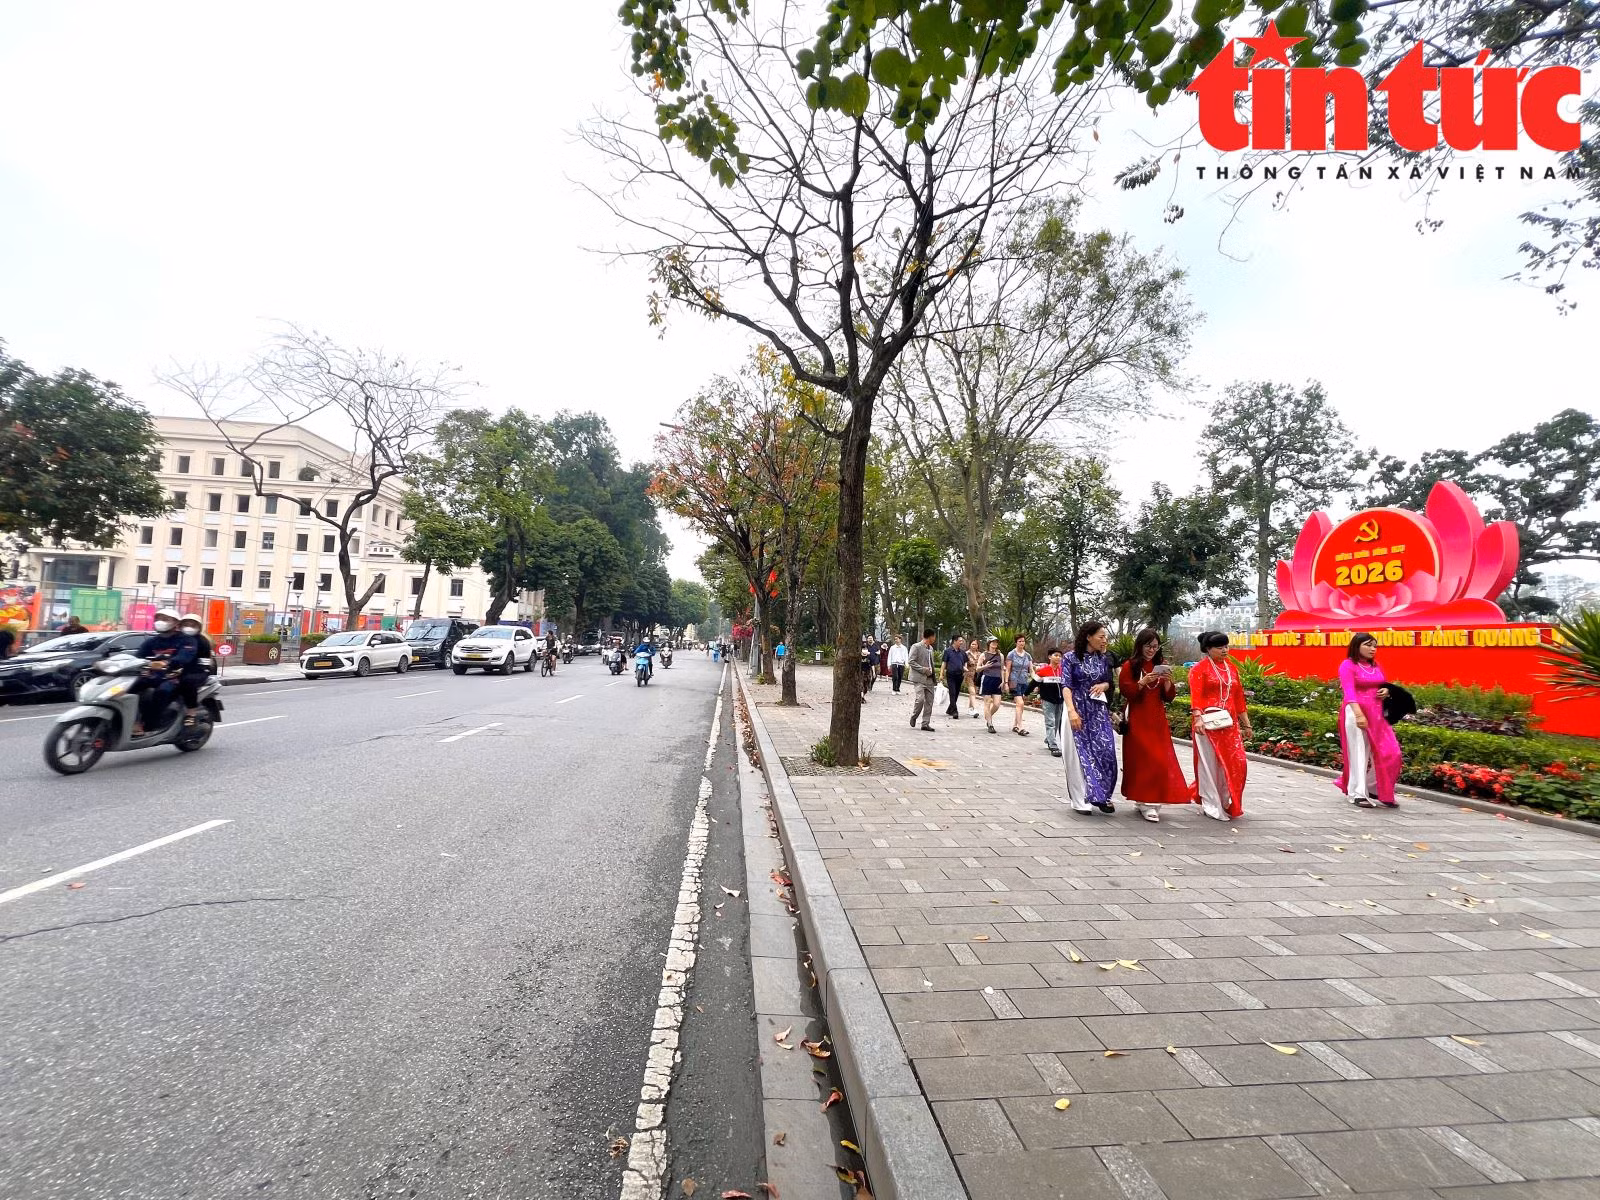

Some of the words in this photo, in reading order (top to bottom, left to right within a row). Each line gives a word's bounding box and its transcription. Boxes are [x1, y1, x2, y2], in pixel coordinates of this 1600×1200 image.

[1335, 559, 1404, 586] 2026
[1419, 624, 1469, 647] ĐẢNG
[1472, 627, 1541, 648] QUANG
